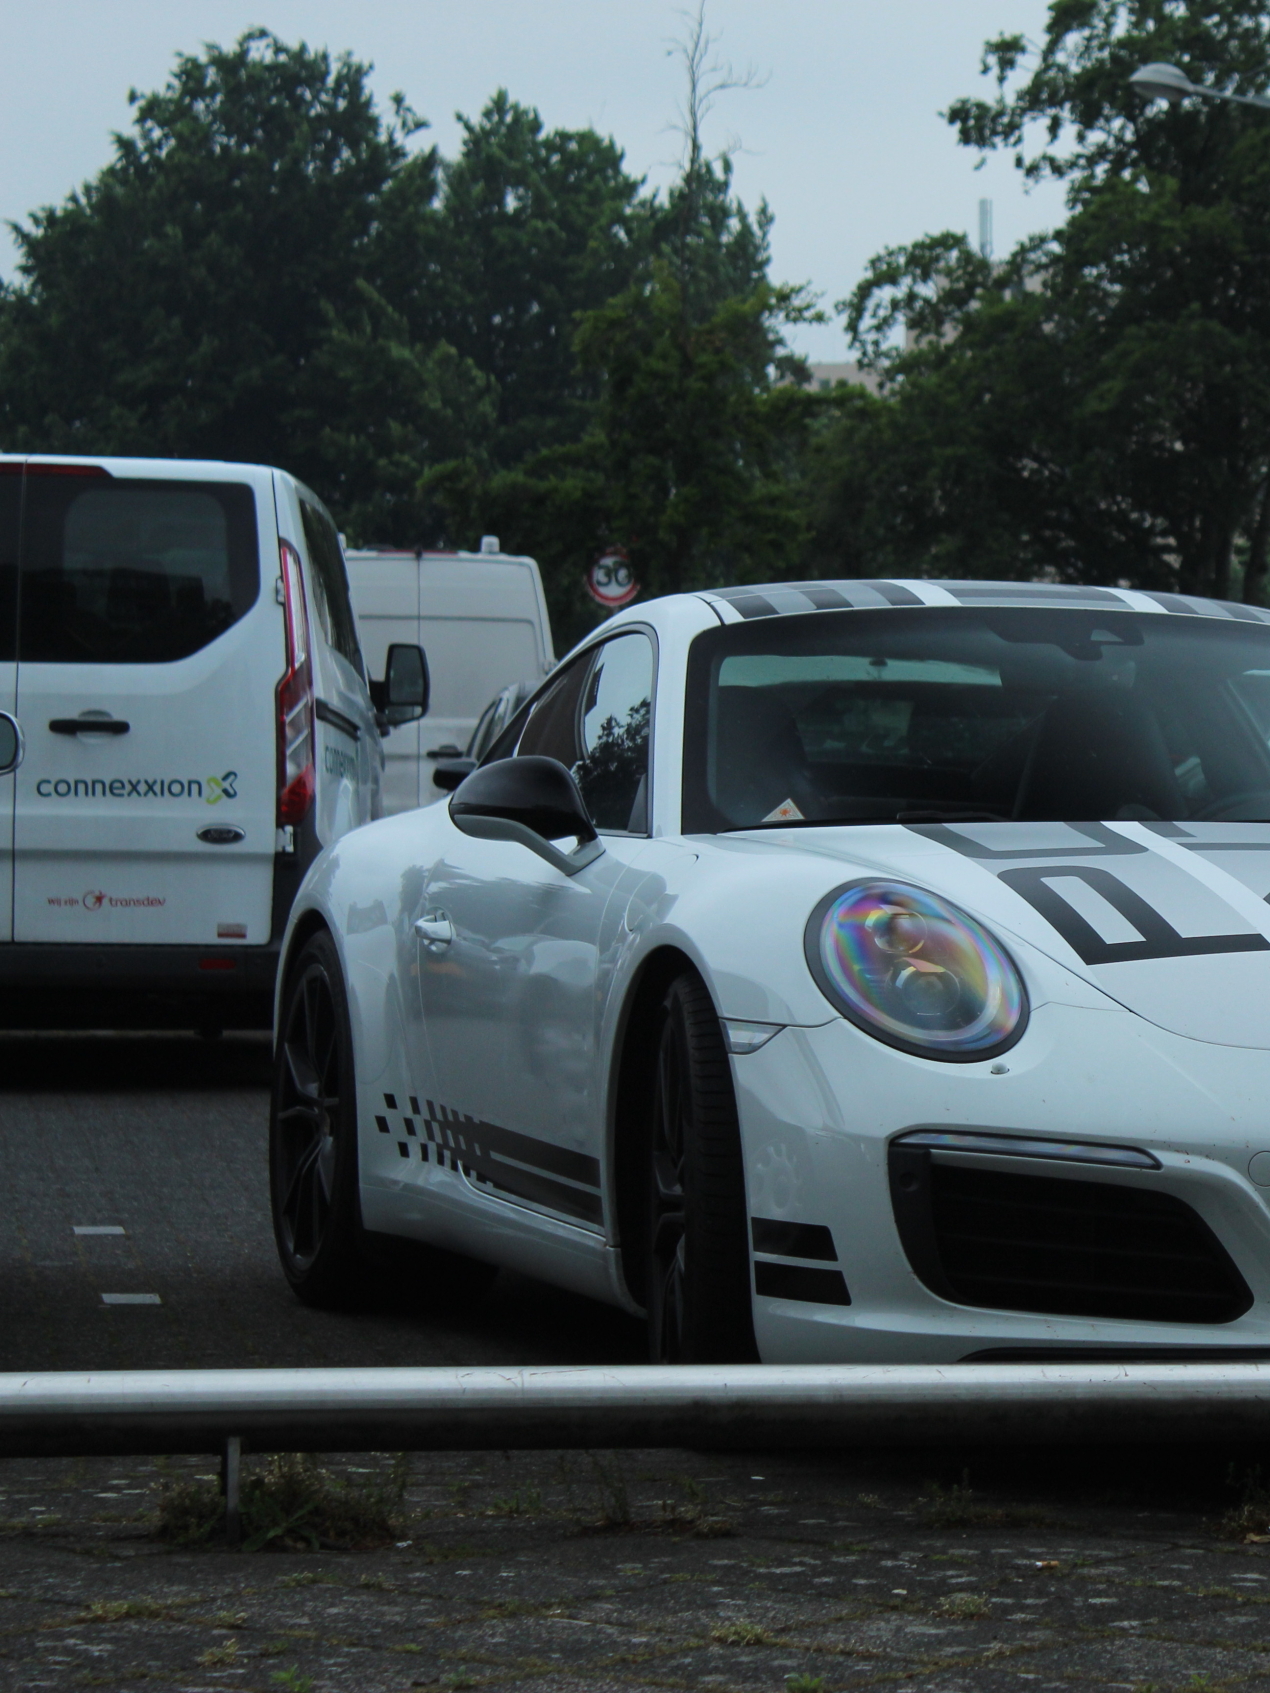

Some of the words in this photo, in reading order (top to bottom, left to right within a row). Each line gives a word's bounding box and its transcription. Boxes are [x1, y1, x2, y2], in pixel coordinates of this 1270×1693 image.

[596, 561, 633, 587] 30
[36, 777, 203, 798] connexxion
[108, 895, 166, 907] transdev
